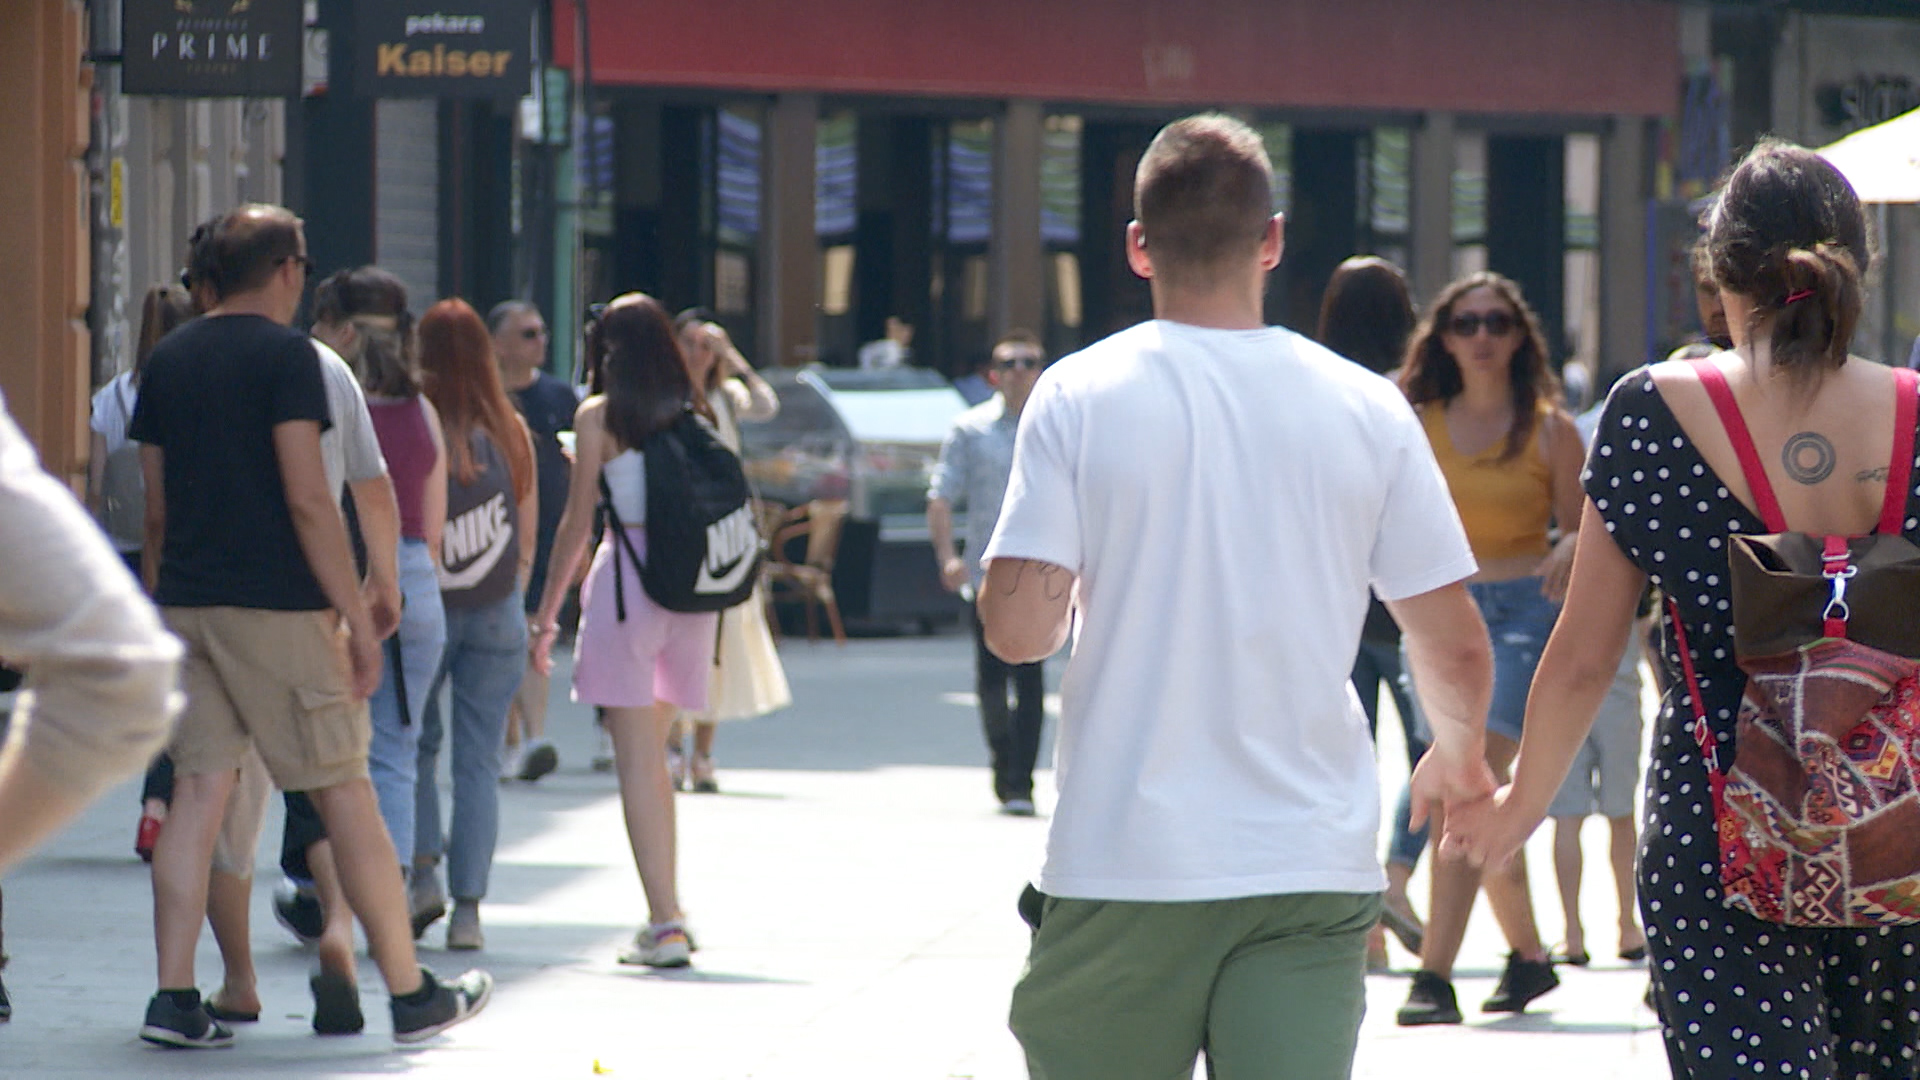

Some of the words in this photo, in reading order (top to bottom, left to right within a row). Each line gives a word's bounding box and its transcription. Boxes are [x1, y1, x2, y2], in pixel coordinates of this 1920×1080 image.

[151, 32, 272, 60] PRIME
[377, 43, 512, 77] Kaiser
[442, 491, 508, 567] NIKE
